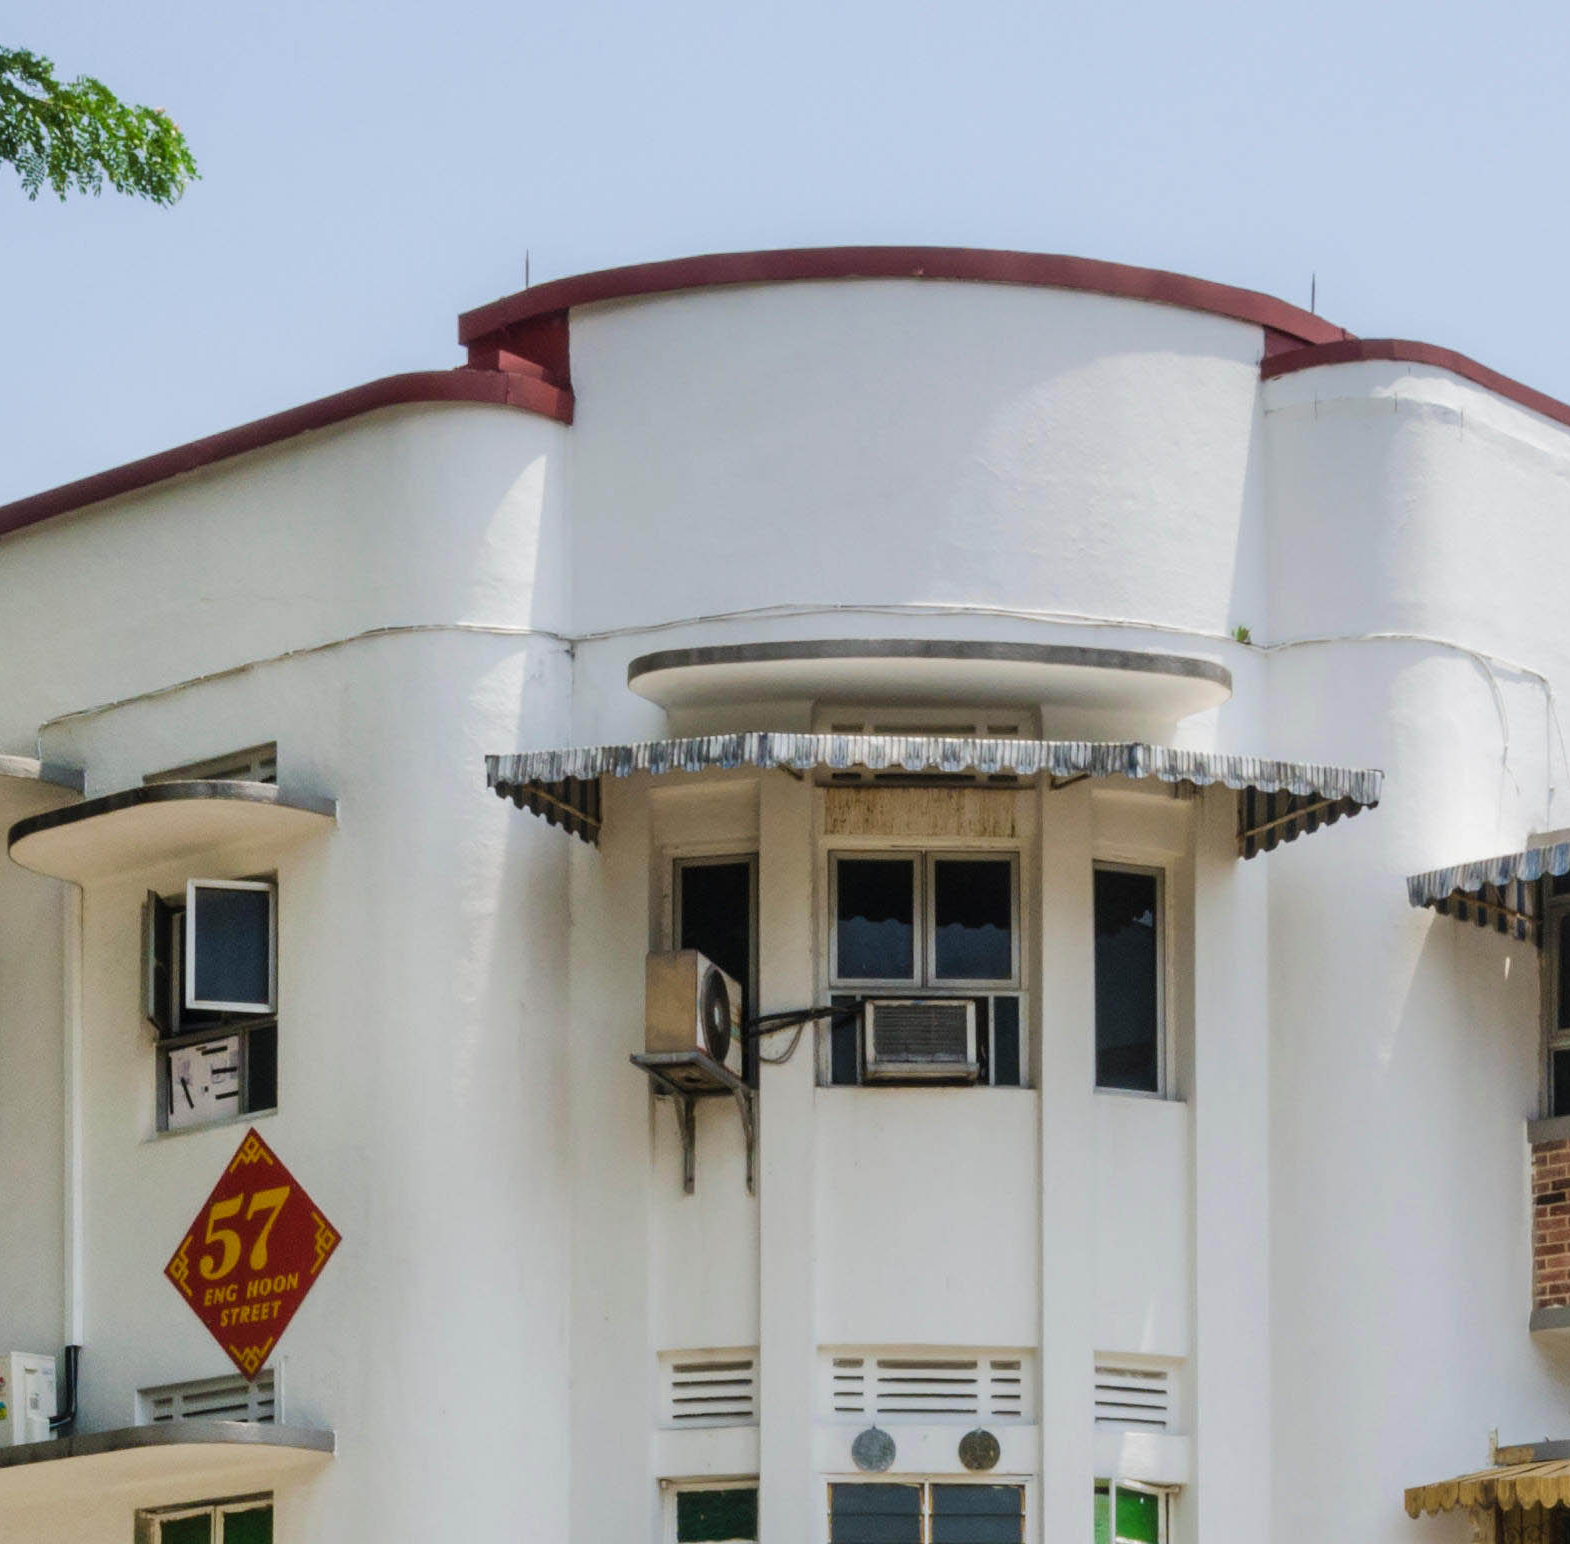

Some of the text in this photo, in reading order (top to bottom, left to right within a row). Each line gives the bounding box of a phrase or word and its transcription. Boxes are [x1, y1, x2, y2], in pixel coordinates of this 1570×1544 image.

[199, 1186, 290, 1280] 57
[204, 1273, 299, 1306] ENG HOON
[220, 1301, 282, 1327] STREET
